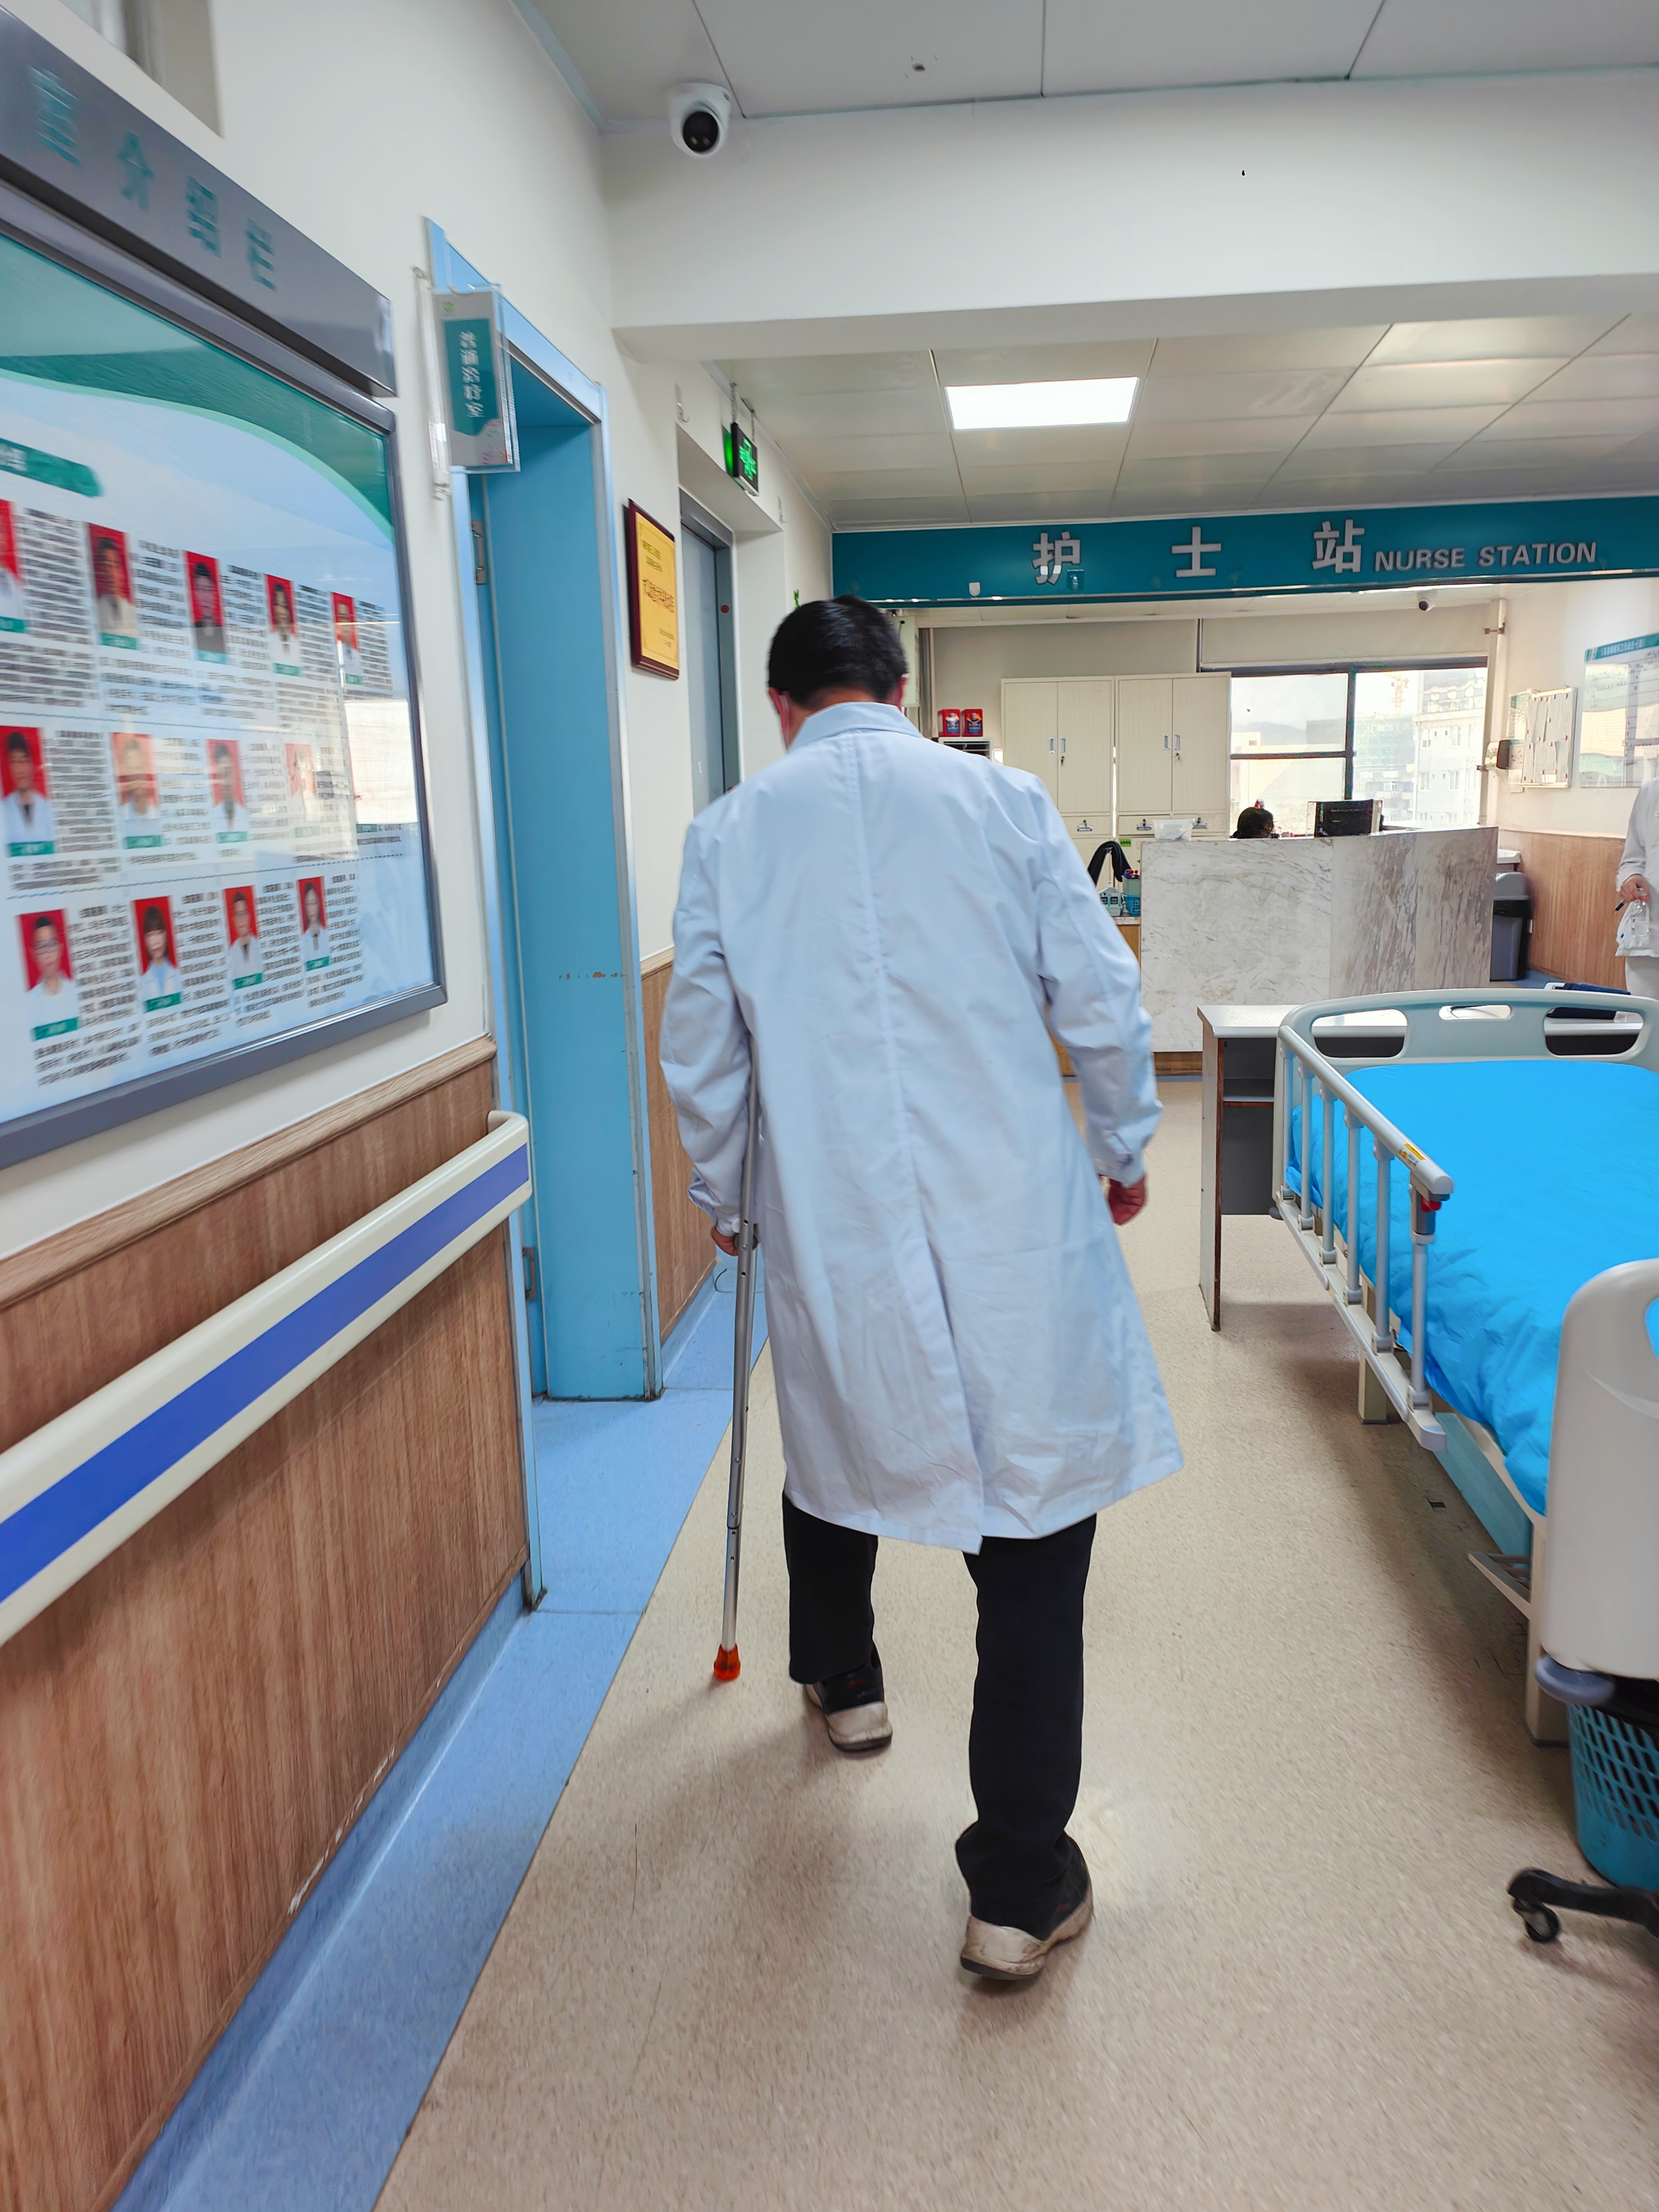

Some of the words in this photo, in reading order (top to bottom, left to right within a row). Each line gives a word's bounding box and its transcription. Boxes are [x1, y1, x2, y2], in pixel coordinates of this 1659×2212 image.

[1031, 519, 1365, 584] 护士站
[1375, 548, 1465, 571] NURSE
[1479, 542, 1596, 566] STATION
